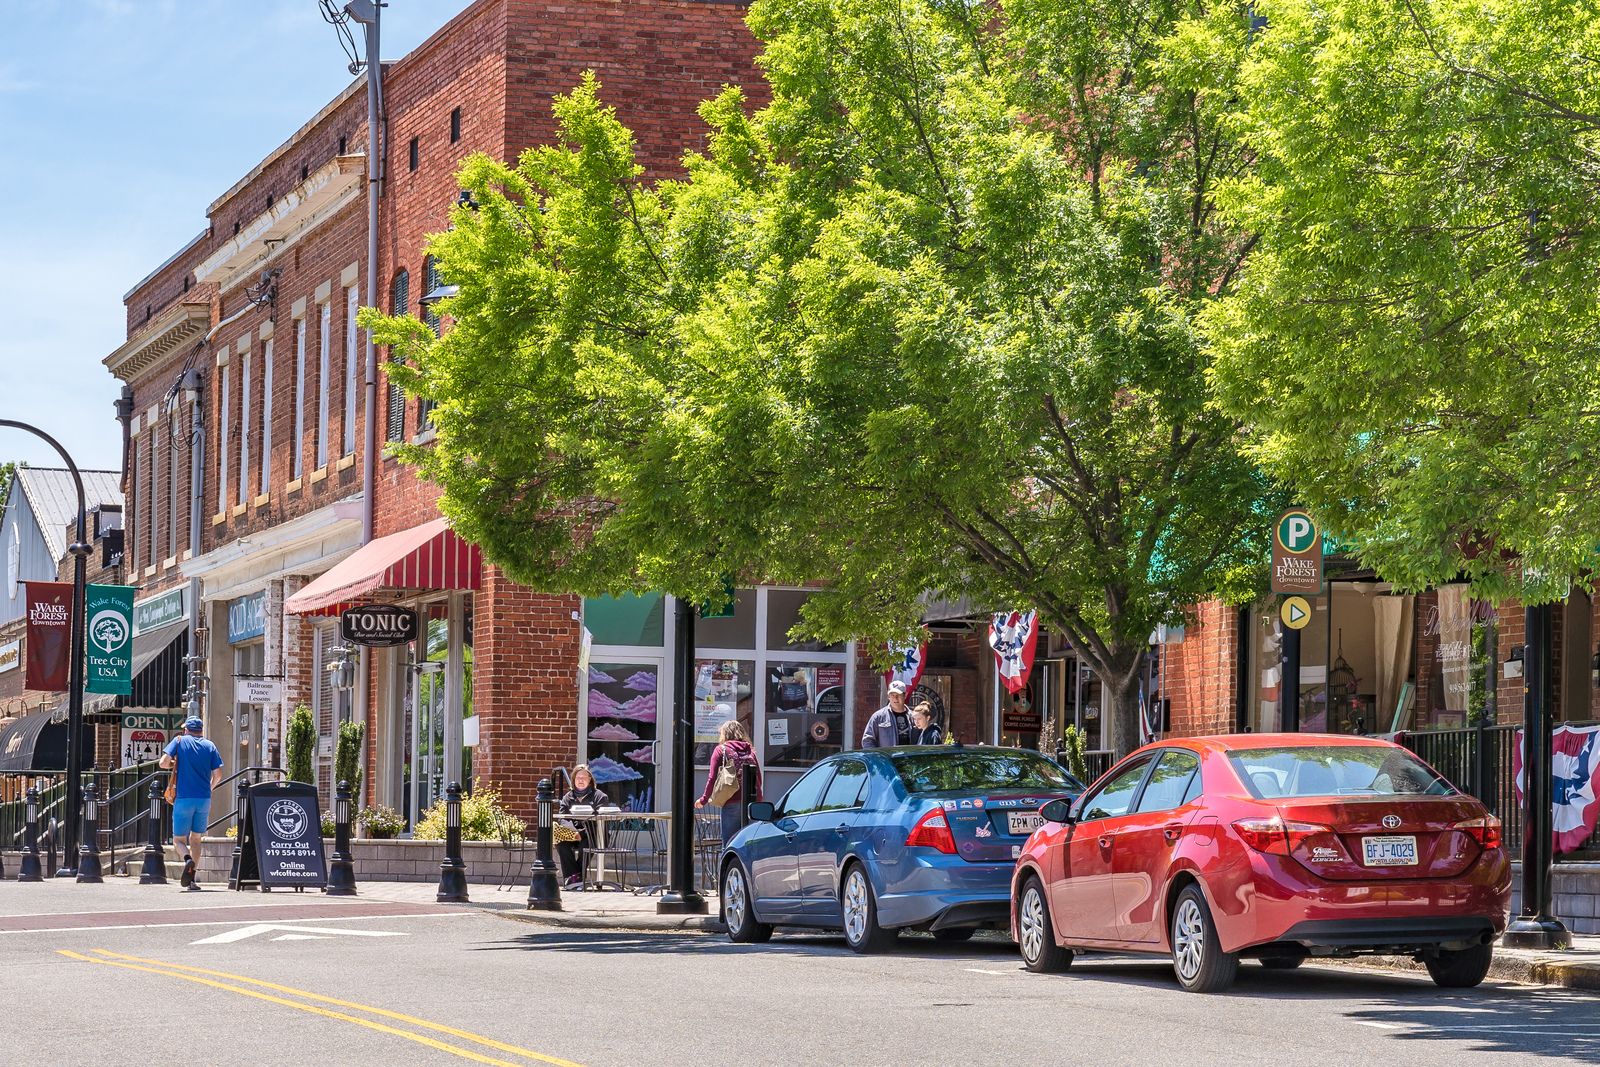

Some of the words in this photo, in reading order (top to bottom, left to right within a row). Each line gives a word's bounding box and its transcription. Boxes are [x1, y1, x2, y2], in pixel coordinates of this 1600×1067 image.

[1288, 517, 1310, 548] P
[1282, 557, 1314, 569] WAKE
[1276, 565, 1317, 577] FOREST
[1279, 575, 1316, 584] downtown
[34, 602, 66, 613] WAKE
[89, 597, 110, 609] Wake
[111, 597, 130, 612] Forest
[30, 609, 69, 620] FOREST
[346, 613, 411, 632] TONIC
[89, 655, 108, 665] Tree
[109, 656, 129, 668] City
[98, 667, 118, 677] USA
[124, 715, 165, 729] OPEN
[1011, 817, 1028, 828] ZPM
[271, 841, 292, 849] Carry
[294, 841, 310, 849] Out
[1366, 844, 1414, 858] BFJ-4029
[280, 861, 306, 869] Online
[269, 869, 318, 877] wfcoffee.com
